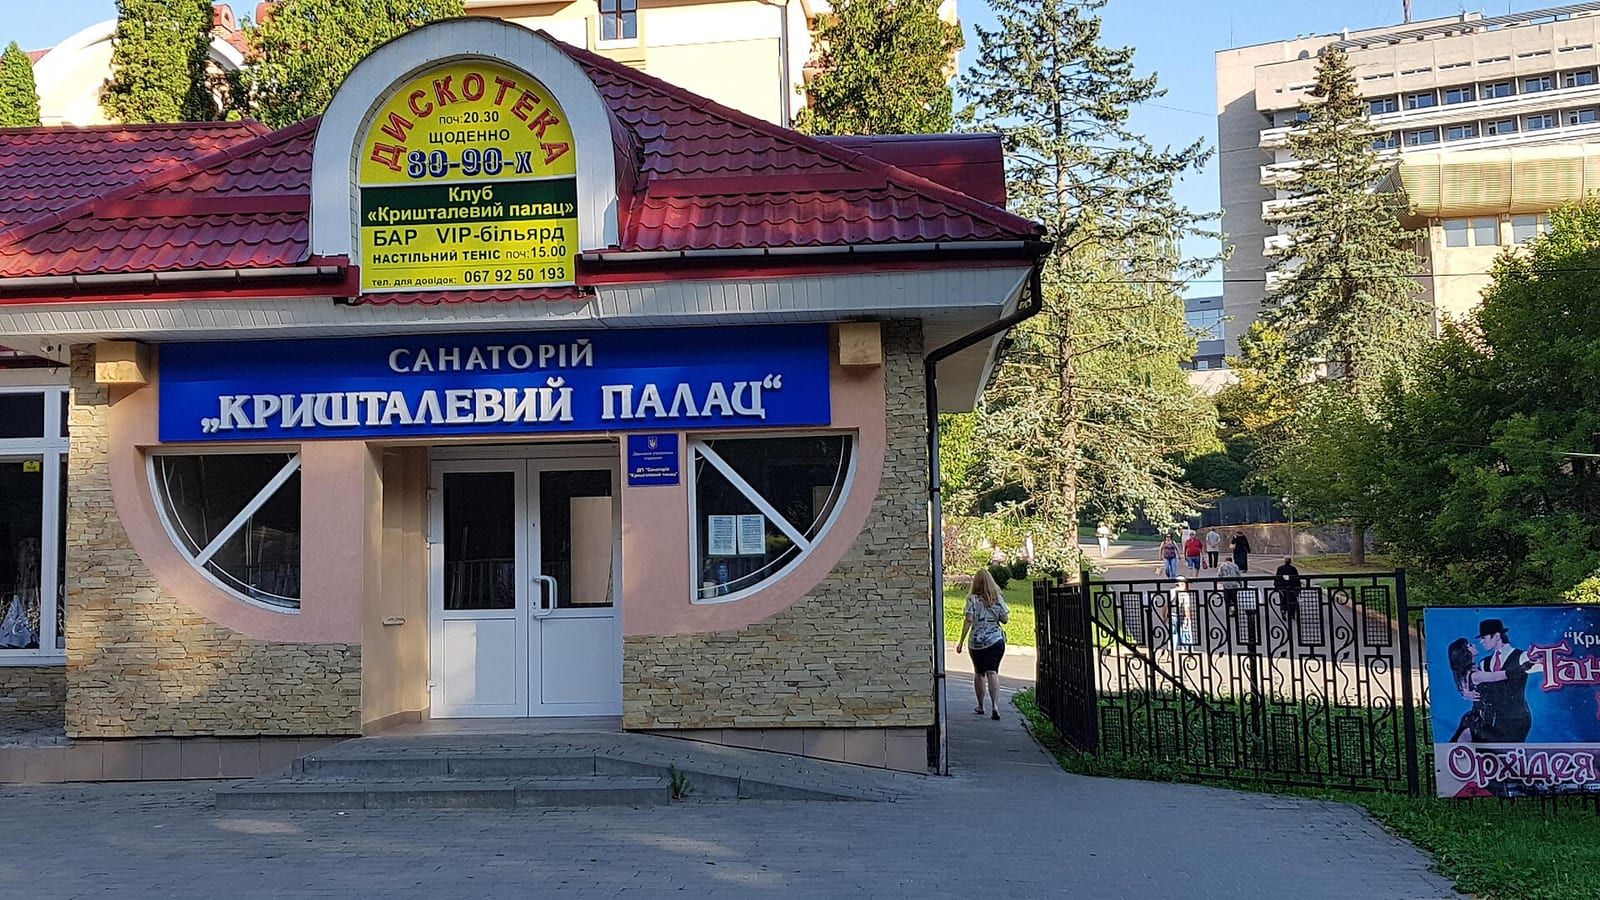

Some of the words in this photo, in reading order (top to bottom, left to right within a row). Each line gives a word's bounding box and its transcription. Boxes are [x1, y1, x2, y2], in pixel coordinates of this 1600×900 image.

[370, 72, 570, 173] ДИСКОТЕКА
[439, 110, 499, 125] поч:20.30
[429, 128, 510, 145] ЩОДЕННО
[449, 185, 494, 205] Клуб
[367, 202, 504, 225] «Кришталевий
[509, 202, 574, 217] палац»
[373, 229, 418, 247] БАР
[436, 225, 565, 245] VIP-більярд
[373, 249, 458, 264] НАСТІЛЬНИЙ
[462, 249, 501, 261] ТЕНІС
[372, 278, 391, 287] тел.
[394, 278, 413, 287] для
[415, 276, 457, 286] довідок:
[464, 270, 490, 284] 067
[495, 269, 512, 282] 92
[517, 268, 534, 281] 50
[540, 267, 565, 280] 193
[388, 338, 594, 373] САНАТОРІЙ
[200, 376, 574, 433] „КРИШТАЛЕВИЙ
[1448, 745, 1596, 788] Орхідея
